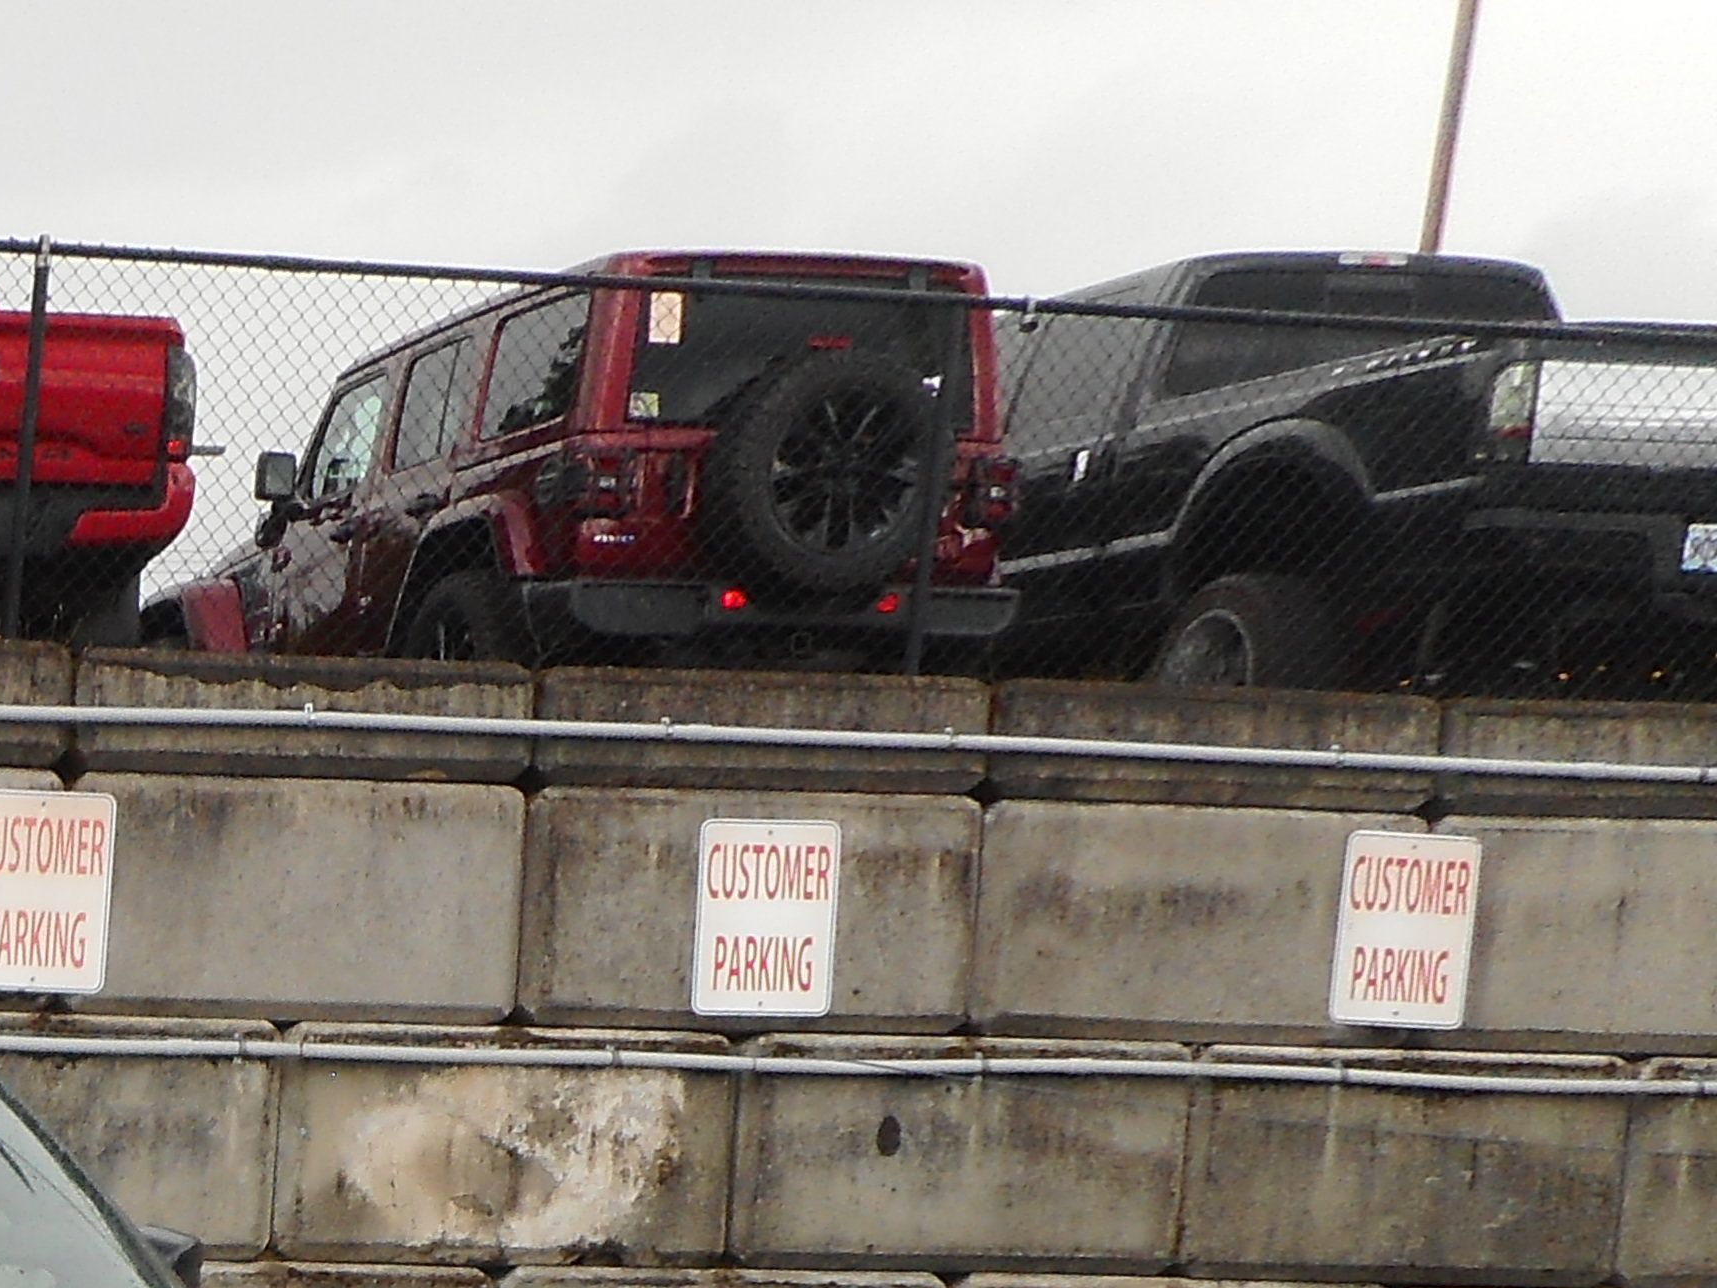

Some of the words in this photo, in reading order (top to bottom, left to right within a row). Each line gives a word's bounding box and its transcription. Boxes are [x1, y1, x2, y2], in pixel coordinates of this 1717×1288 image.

[706, 842, 831, 901] CUSTOMER
[1349, 854, 1471, 916] CUSTOMER
[711, 934, 814, 992] PARKING
[1349, 945, 1449, 1005] PARKING
